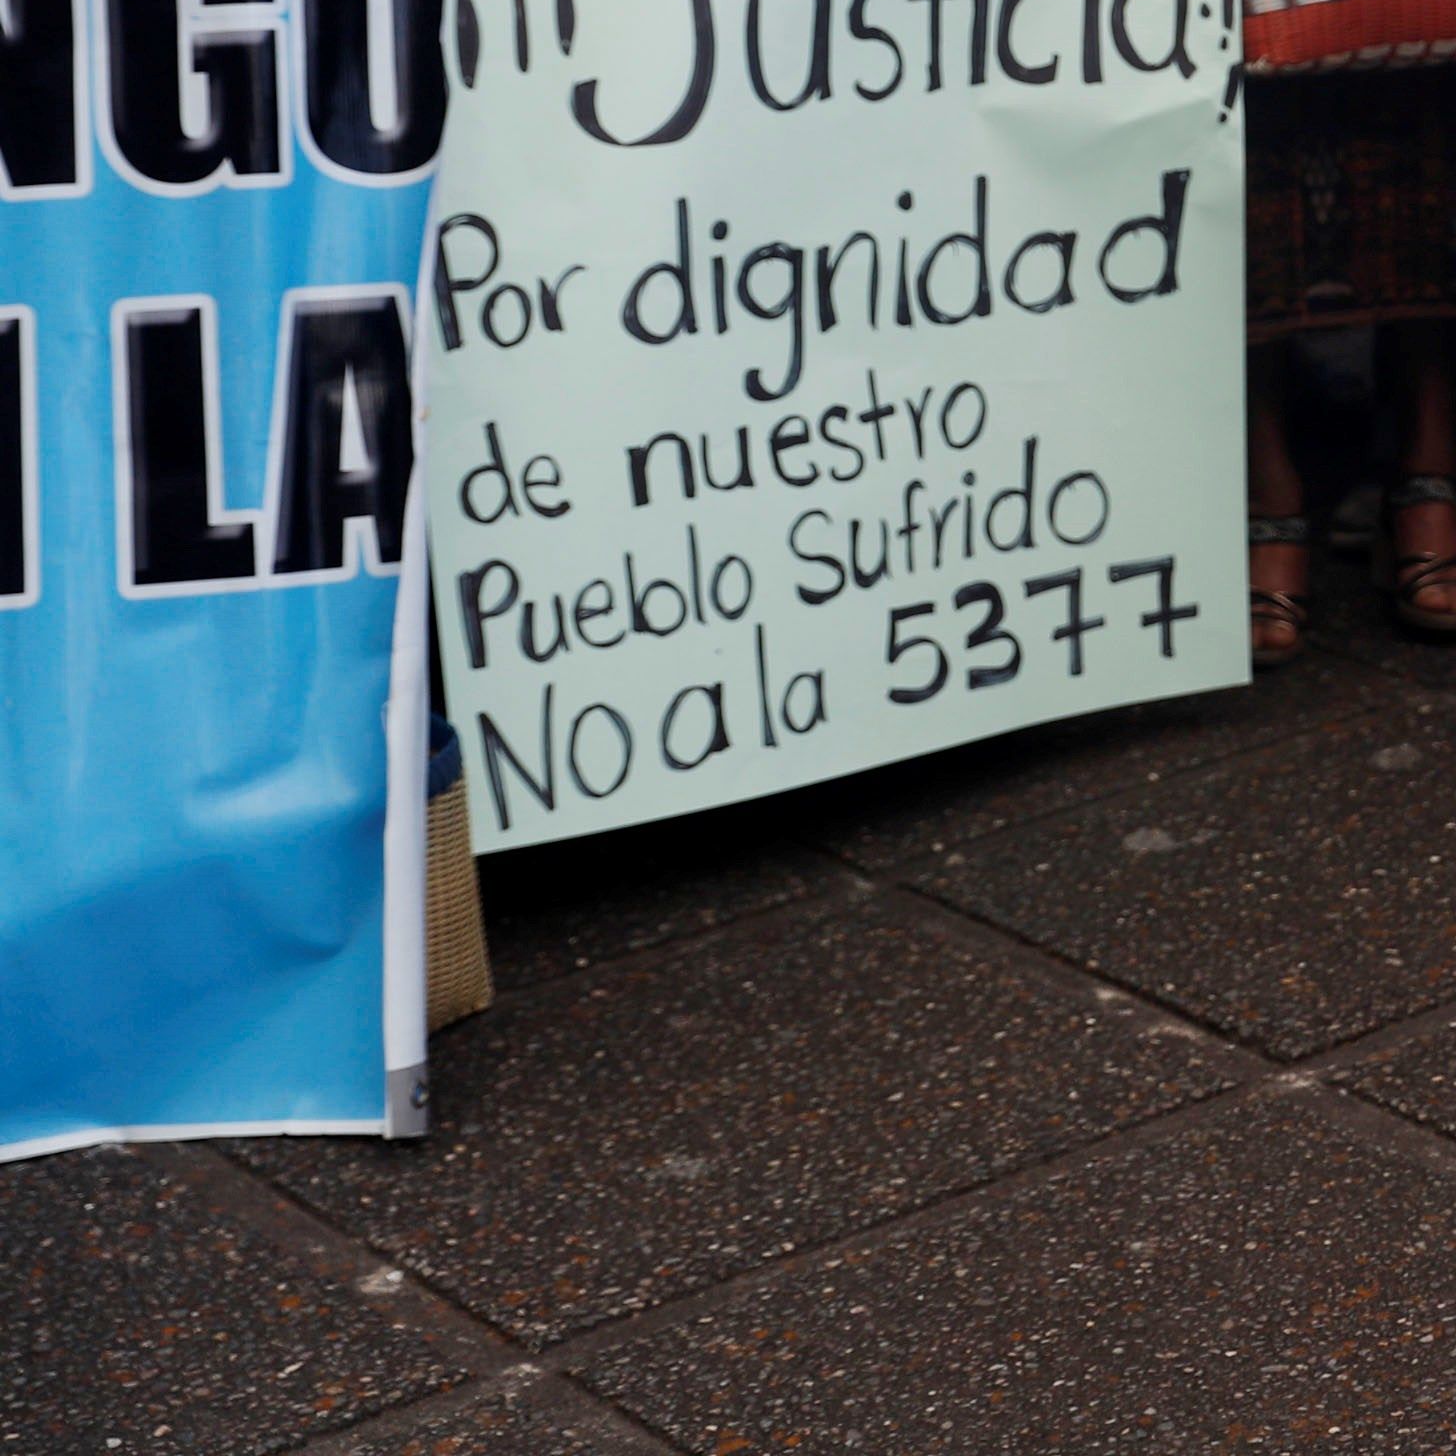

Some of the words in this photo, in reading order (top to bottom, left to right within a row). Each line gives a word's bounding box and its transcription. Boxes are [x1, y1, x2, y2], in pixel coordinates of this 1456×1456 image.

[434, 212, 586, 352] Por
[622, 168, 1192, 402] dignidad
[118, 289, 415, 592] LA
[458, 422, 571, 526] de
[625, 369, 988, 507] nuestro
[456, 525, 753, 671] Pueblo
[884, 555, 1199, 704] 5377
